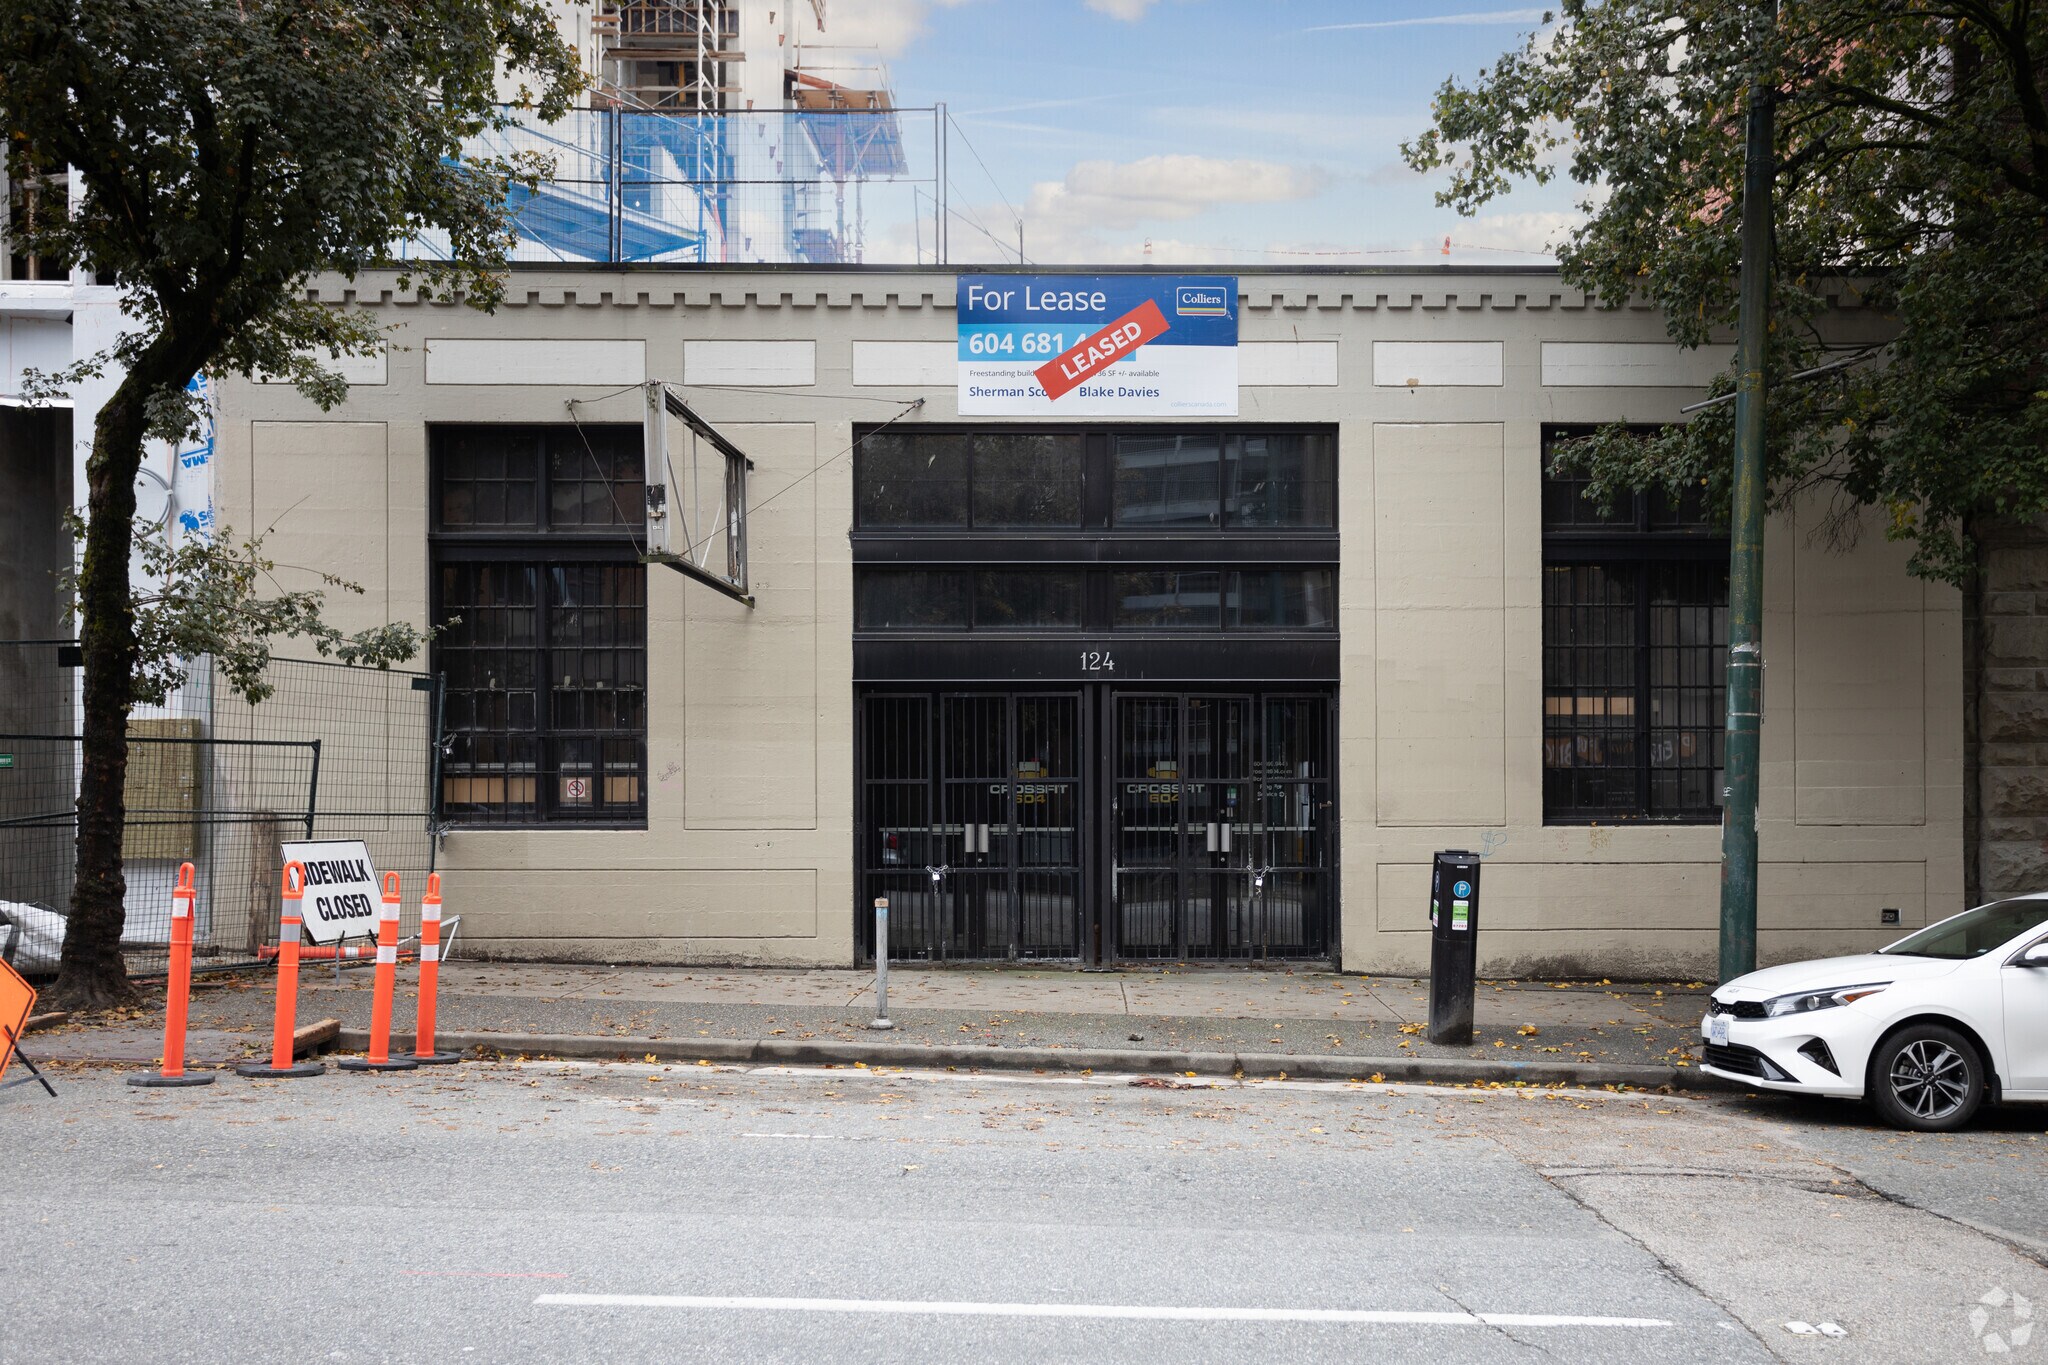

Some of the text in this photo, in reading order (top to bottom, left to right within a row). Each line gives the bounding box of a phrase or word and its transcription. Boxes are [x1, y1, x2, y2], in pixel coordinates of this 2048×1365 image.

[969, 286, 1106, 311] For Lease
[1182, 293, 1221, 304] Colliers
[969, 333, 1015, 354] 604
[1021, 333, 1063, 354] 681
[1060, 321, 1142, 380] LEASED
[969, 370, 1016, 378] Freestanding
[969, 386, 1048, 397] Sherman Sco
[1080, 386, 1160, 397] Blake Davies
[1080, 651, 1115, 671] 124
[316, 894, 372, 921] CLOSED
